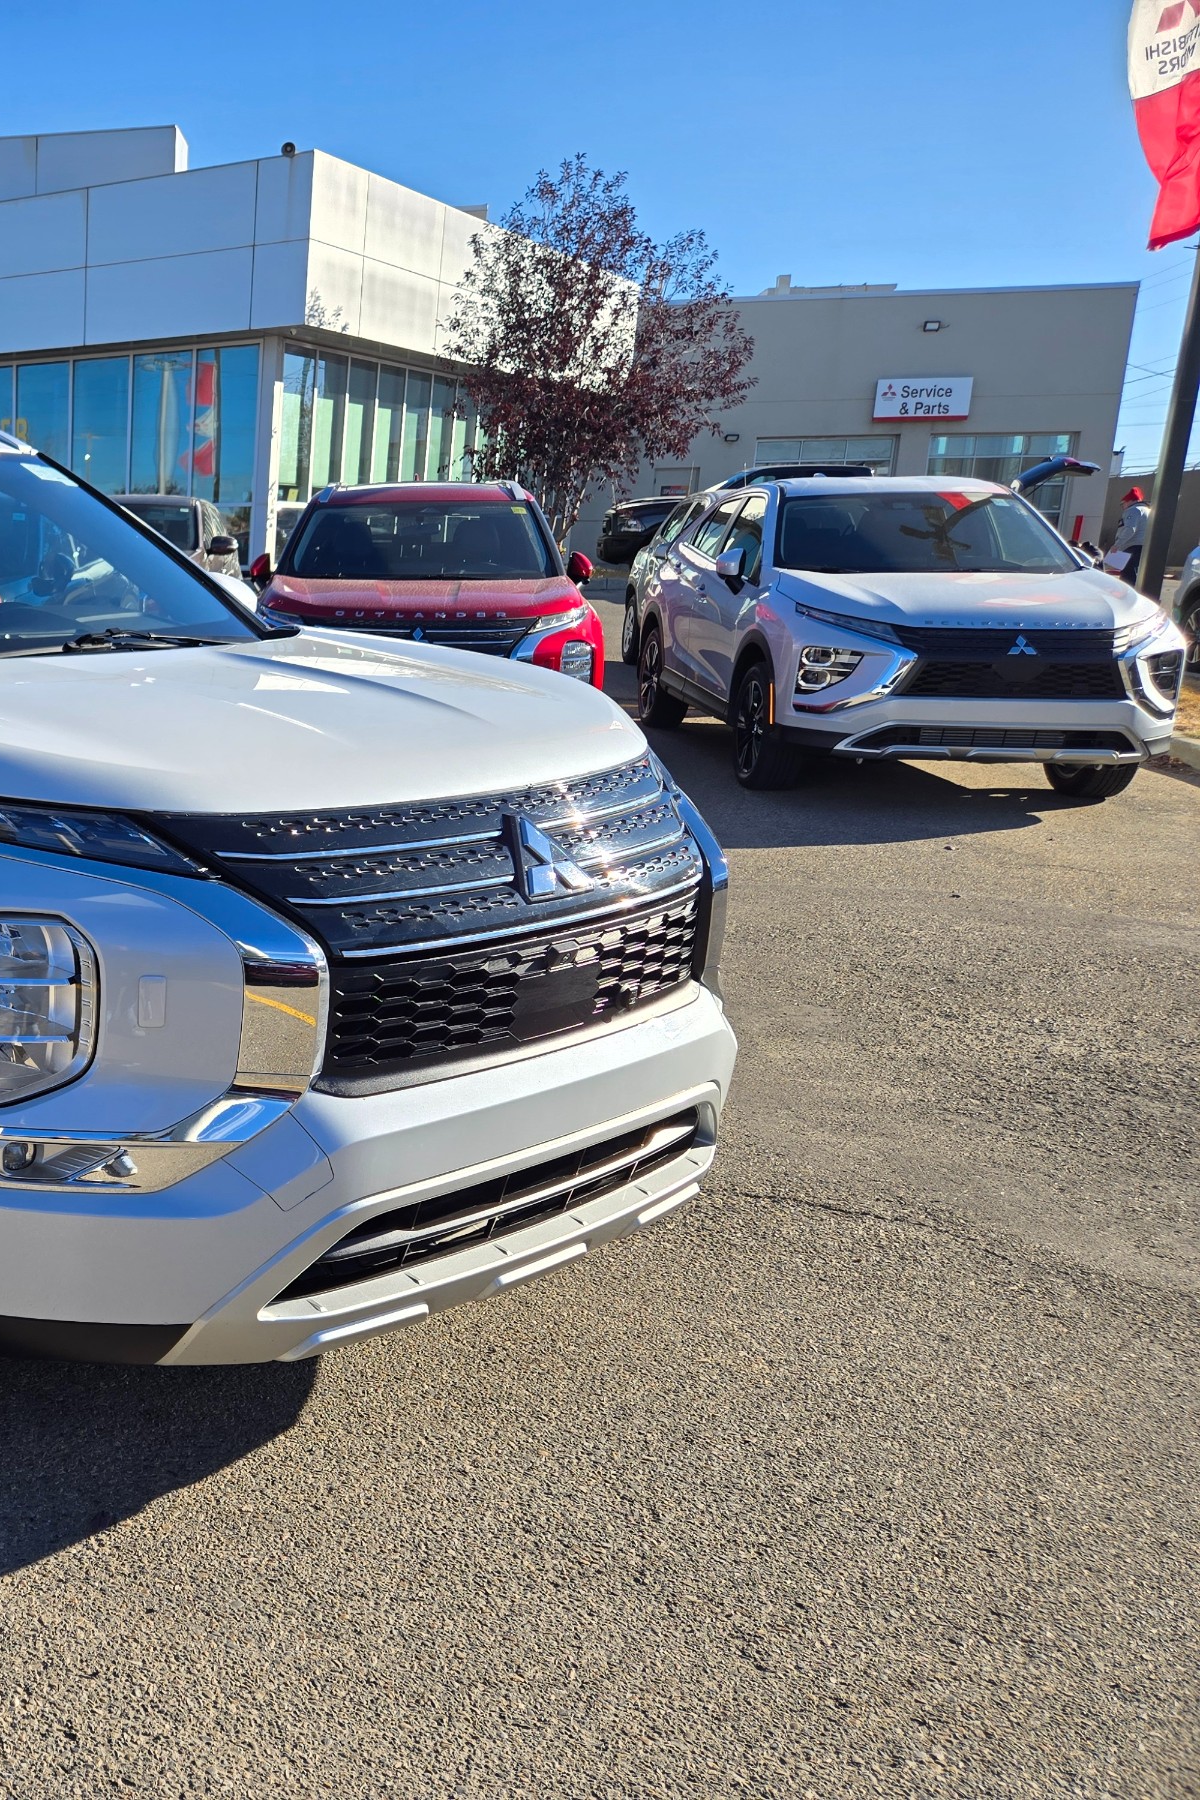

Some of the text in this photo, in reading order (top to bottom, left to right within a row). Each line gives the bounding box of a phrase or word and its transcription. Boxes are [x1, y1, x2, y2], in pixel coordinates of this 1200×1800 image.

[901, 385, 953, 398] Service
[899, 402, 950, 415] & Parts
[335, 610, 507, 619] OUTLANDER
